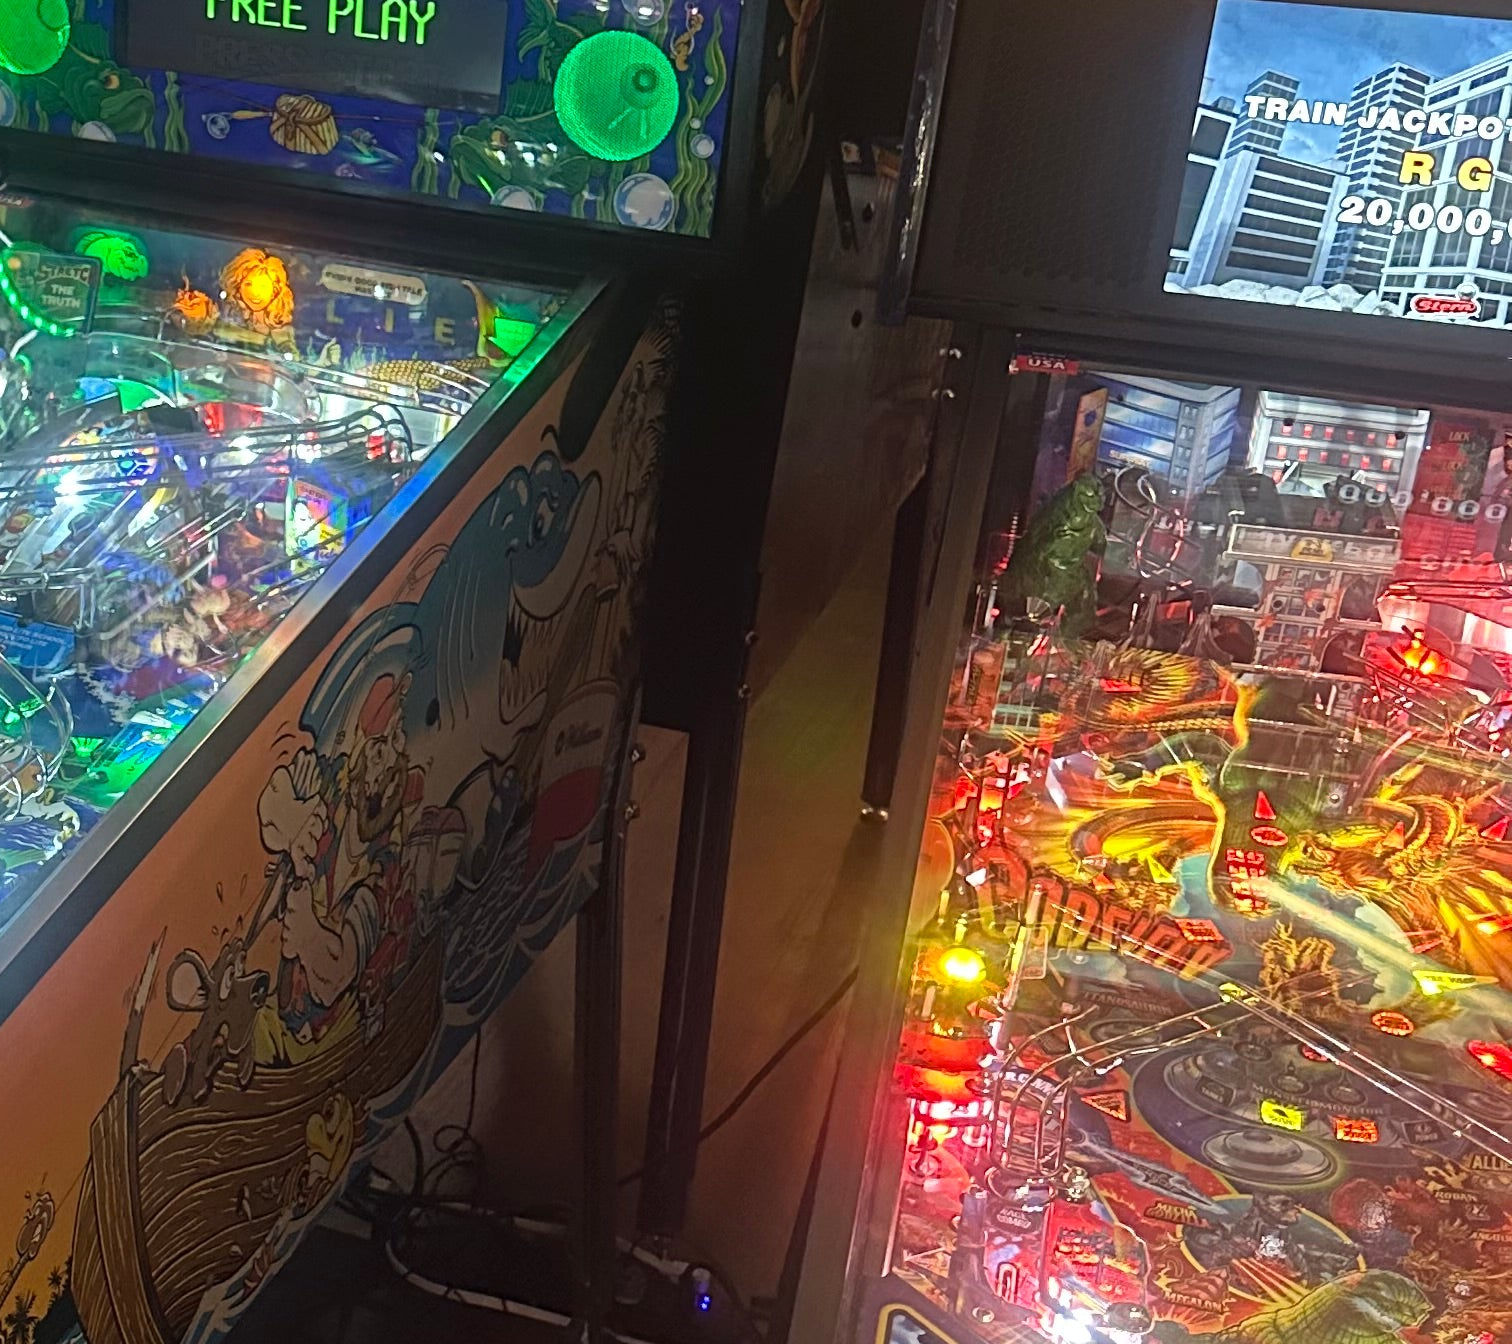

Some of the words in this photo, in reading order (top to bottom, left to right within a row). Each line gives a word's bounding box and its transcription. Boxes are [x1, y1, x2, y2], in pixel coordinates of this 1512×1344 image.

[1245, 95, 1349, 126] TRAIN
[1399, 151, 1434, 186] R
[1457, 158, 1494, 192] G
[51, 283, 76, 296] THE
[42, 294, 81, 309] TRUTH
[1028, 358, 1066, 370] USA
